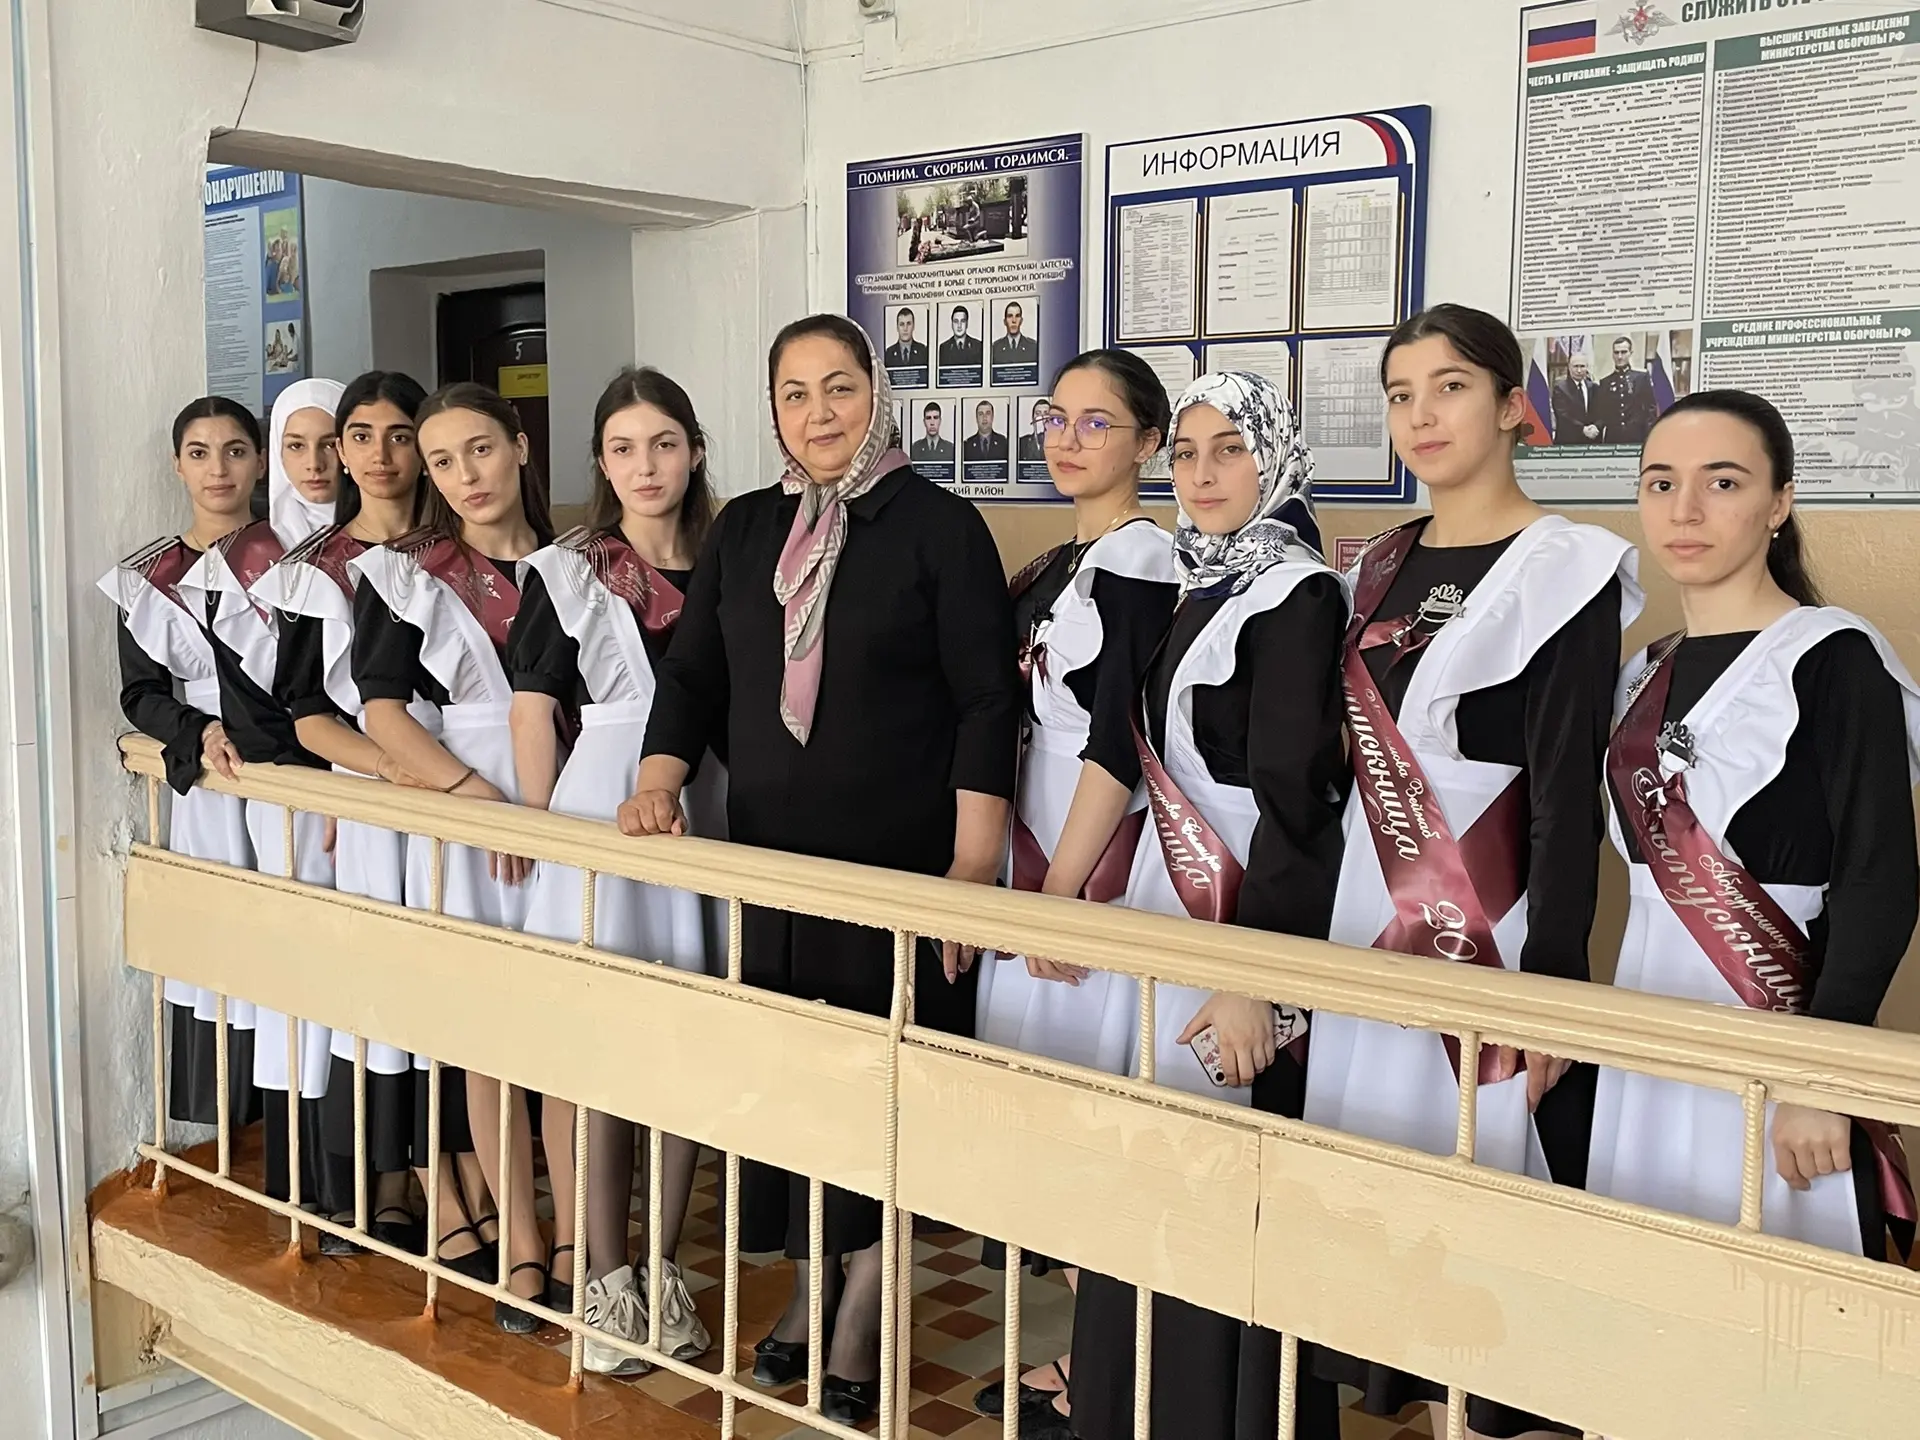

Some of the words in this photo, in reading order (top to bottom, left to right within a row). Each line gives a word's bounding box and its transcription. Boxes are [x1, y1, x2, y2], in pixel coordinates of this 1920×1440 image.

[1760, 31, 1803, 48] ВЫСШИЕ
[1804, 25, 1850, 41] УЧЕБНЫЕ
[1851, 15, 1910, 34] ЗАВЕДЕНИЯ
[1761, 42, 1836, 61] МИНИСТЕРСТВА
[1837, 35, 1887, 50] ОБОРОНЫ
[1888, 31, 1906, 43] РФ
[1528, 74, 1554, 87] ЧЕСТЬ
[1555, 73, 1561, 83] И
[1562, 65, 1611, 82] ПРИЗВАНИЕ
[1616, 58, 1667, 75] ЗАЩИЩАТЬ
[1668, 52, 1705, 68] РОДИНУ
[1143, 131, 1340, 177] ИНФОРМАЦИЯ
[859, 168, 919, 185] ПОМНИМ.
[924, 159, 988, 178] СКОРБИМ.
[995, 149, 1069, 169] ГОРДИМСЯ.
[863, 283, 908, 293] ПРИНИМАВШИЕ
[909, 280, 936, 289] УЧАСТИЕ
[944, 278, 965, 287] БОРЬБЕ
[974, 273, 1020, 284] ТЕРРОРИЗМОМ
[1029, 270, 1066, 280] ПОГИБШИЕ
[896, 269, 965, 280] ПРАВООХРАНИТЕЛЬНЫХ
[967, 265, 996, 275] ОРГАНОВ
[997, 263, 1038, 273] РЕСПУБЛИКИ
[888, 293, 901, 301] ПРИ
[903, 290, 945, 300] ВЫПОЛНЕНИИ
[946, 287, 983, 297] СЛУЖЕБНЫХ
[1731, 321, 1774, 334] СРЕДНИЕ
[1775, 314, 1882, 331] ПРОФЕССИОНАЛЬНЫЕ
[1706, 336, 1767, 349] УЧРЕЖДЕНИЯ
[1767, 331, 1842, 345] МИНИСТЕРСТВА
[1843, 328, 1893, 341] ОБОРОНЫ
[1894, 327, 1911, 338] РФ
[515, 341, 523, 360] 5
[975, 485, 1004, 495] РАЙОН
[1429, 583, 1463, 604] 2026
[1404, 777, 1441, 840] Зейнаб
